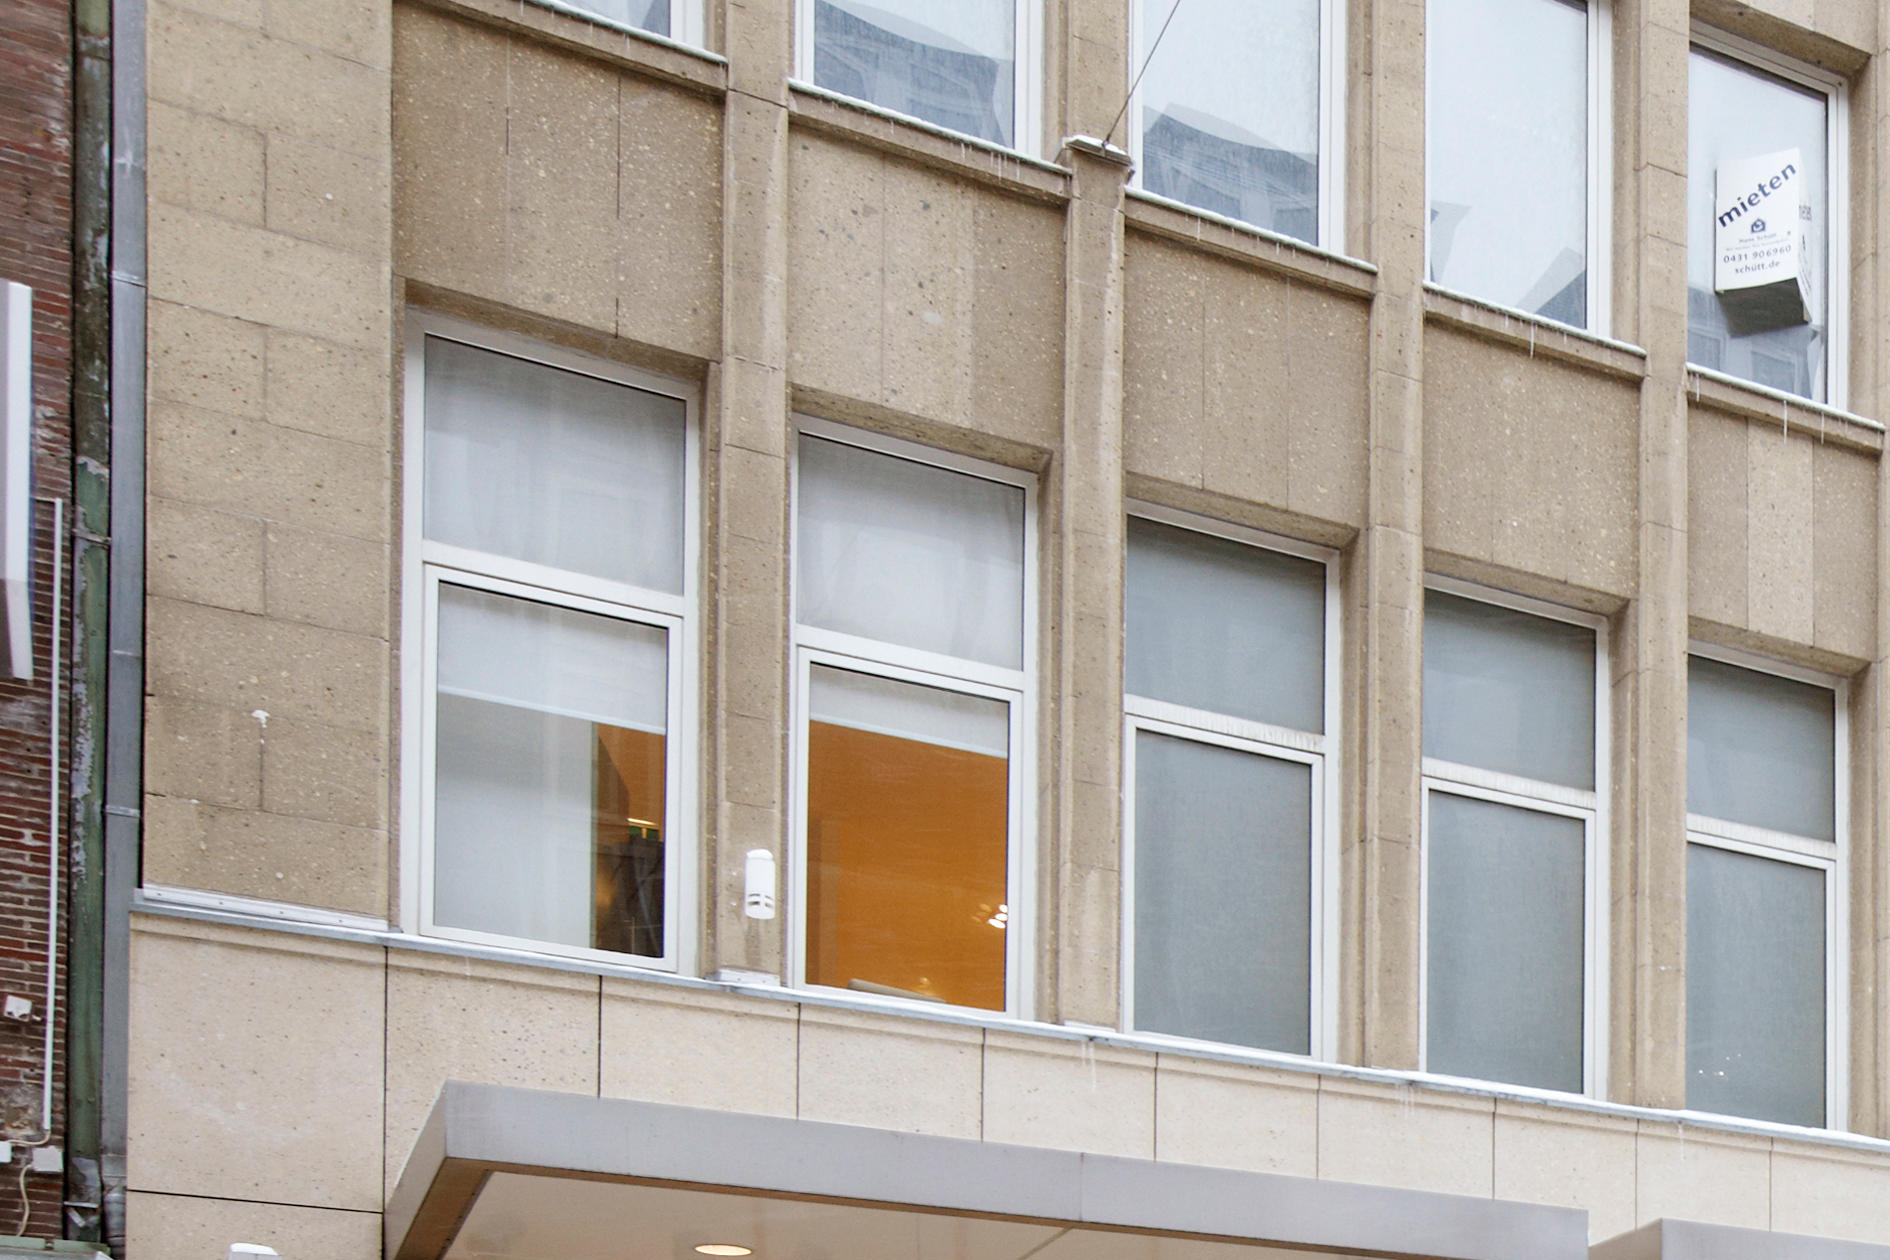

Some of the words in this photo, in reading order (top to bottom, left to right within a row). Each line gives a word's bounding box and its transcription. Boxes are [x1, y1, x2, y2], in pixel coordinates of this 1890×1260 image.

[1718, 163, 1797, 228] mieten
[1723, 253, 1748, 263] 0431
[1752, 245, 1792, 259] 906960
